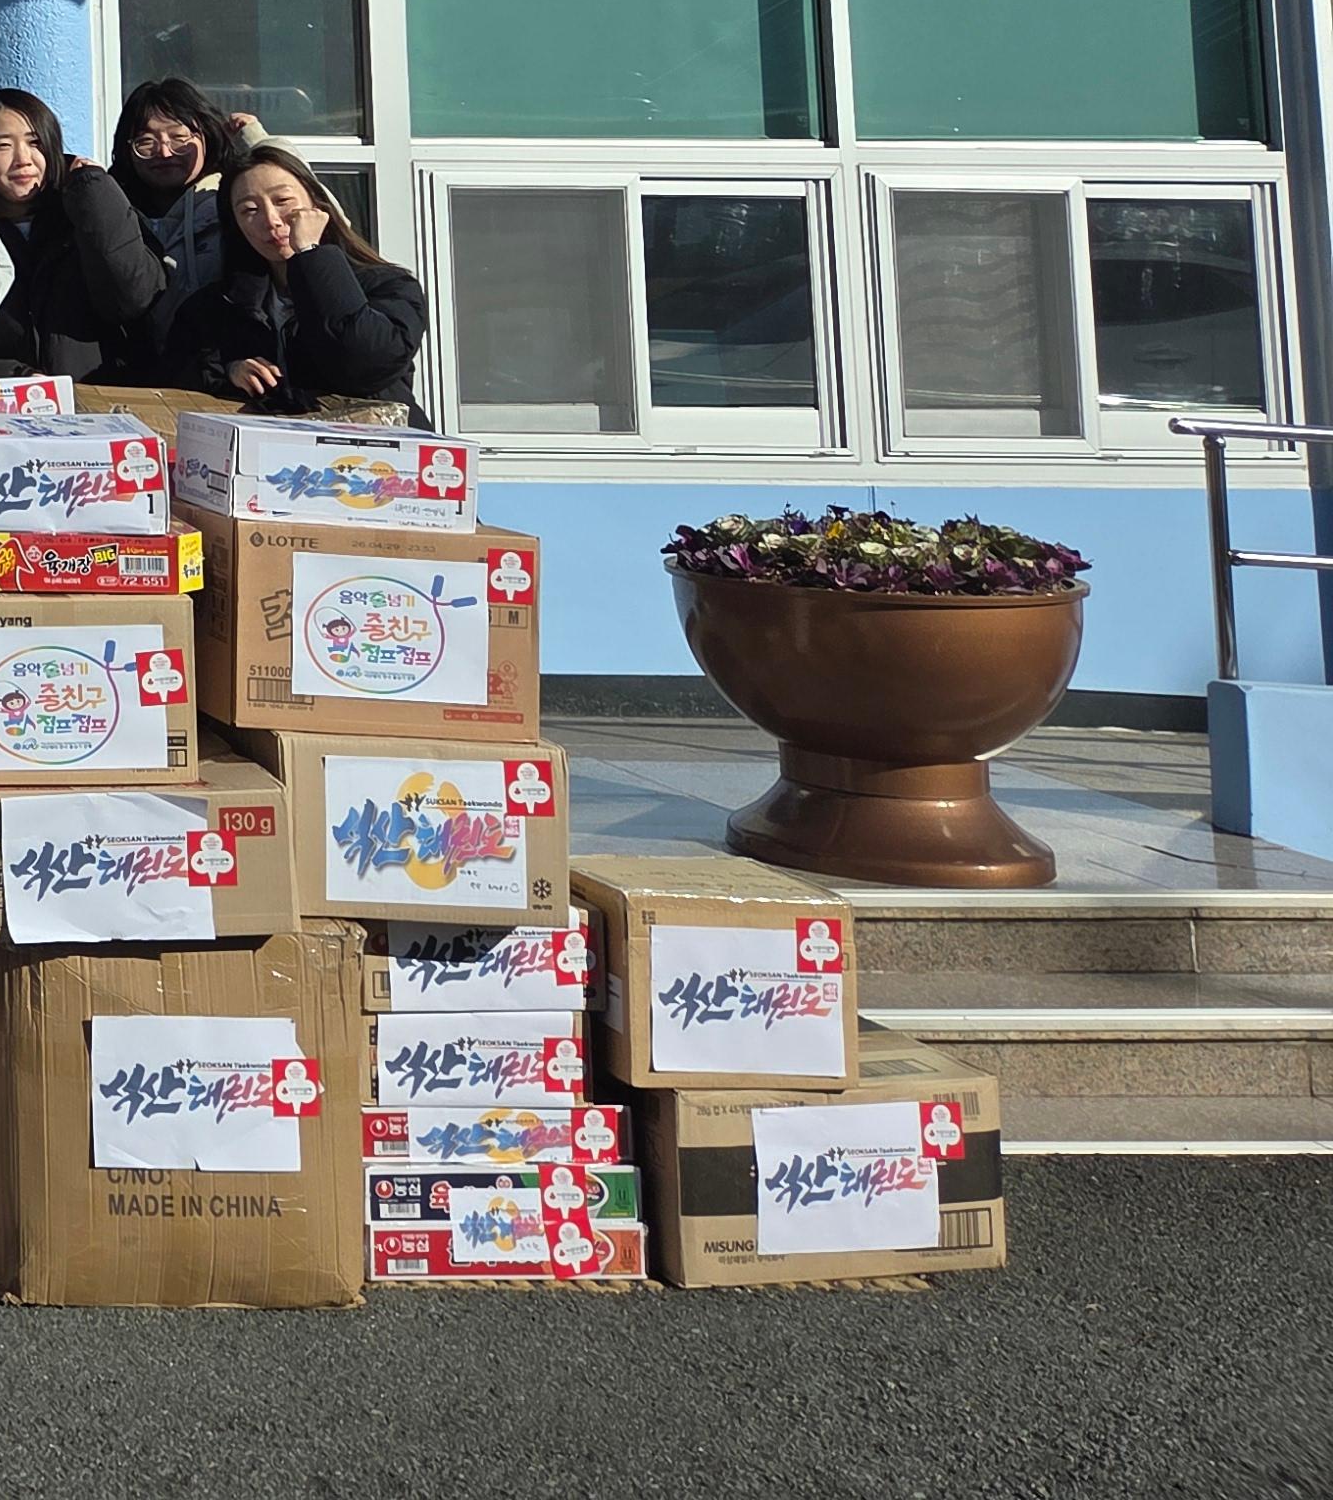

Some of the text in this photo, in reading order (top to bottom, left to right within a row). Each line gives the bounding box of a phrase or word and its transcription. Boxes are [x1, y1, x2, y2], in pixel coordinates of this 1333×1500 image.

[267, 535, 320, 550] LOTTE
[40, 547, 116, 576] 육개장 BIG
[120, 576, 165, 586] 72 551
[360, 612, 433, 642] 줄친구
[507, 610, 519, 624] M
[360, 644, 432, 666] 점프점프
[35, 683, 107, 712] 줄친구
[36, 713, 107, 735] 점프점프
[222, 812, 273, 835] 130 g
[107, 1194, 283, 1218] MADE IN CHINA
[703, 1240, 754, 1253] MISUNG
